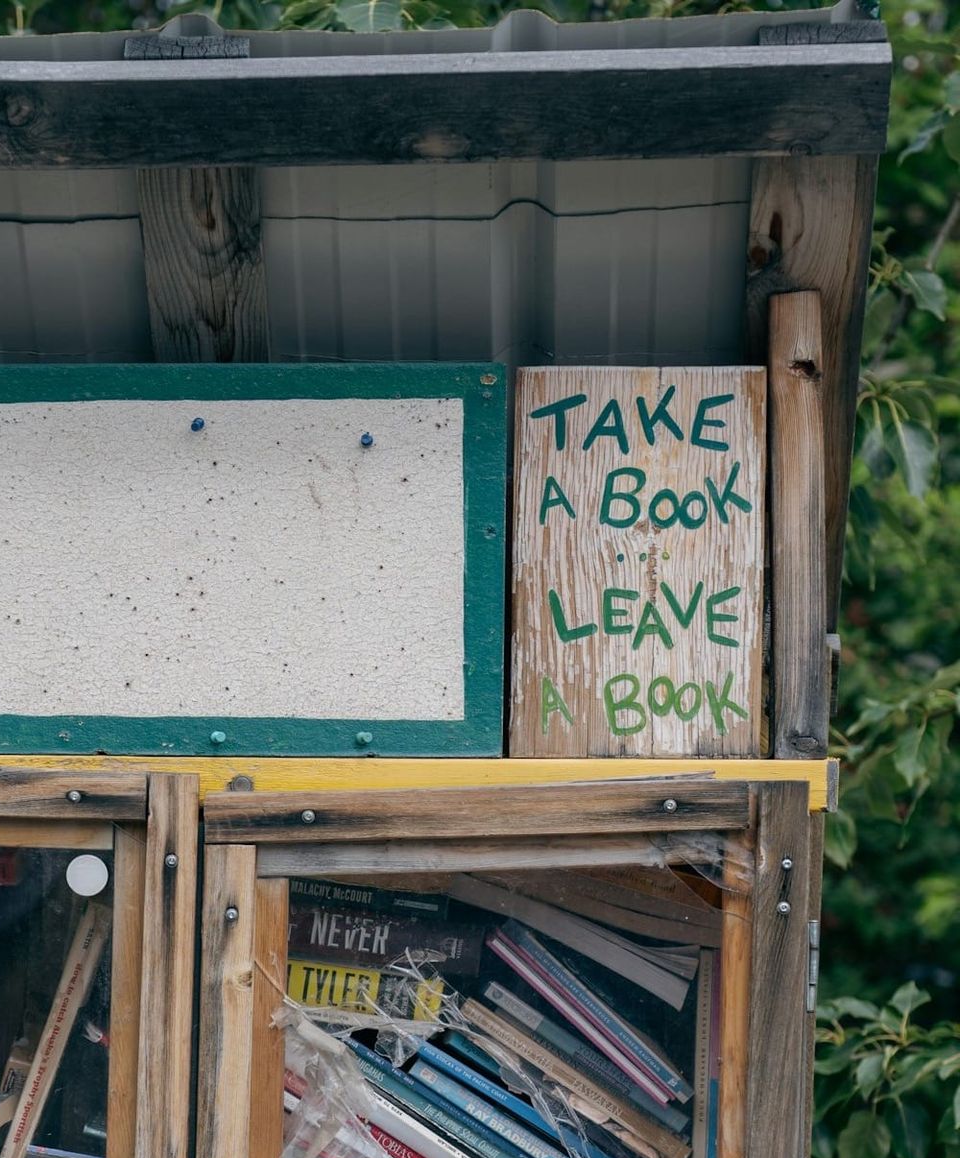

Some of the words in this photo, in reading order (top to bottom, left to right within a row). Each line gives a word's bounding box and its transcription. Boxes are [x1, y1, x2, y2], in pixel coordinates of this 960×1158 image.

[531, 386, 734, 454] TAKE
[540, 476, 575, 524] A
[599, 462, 751, 529] BOOK
[548, 581, 739, 649] LEAVE
[541, 675, 573, 733] A
[604, 671, 748, 735] BOOK
[291, 880, 330, 898] MALACHY
[333, 887, 373, 904] McCOURT
[310, 911, 389, 955] NEVER
[57, 995, 73, 1022] catch
[28, 1065, 47, 1099] Trophy
[13, 1101, 35, 1145] Sportfish
[463, 1103, 491, 1125] RAY
